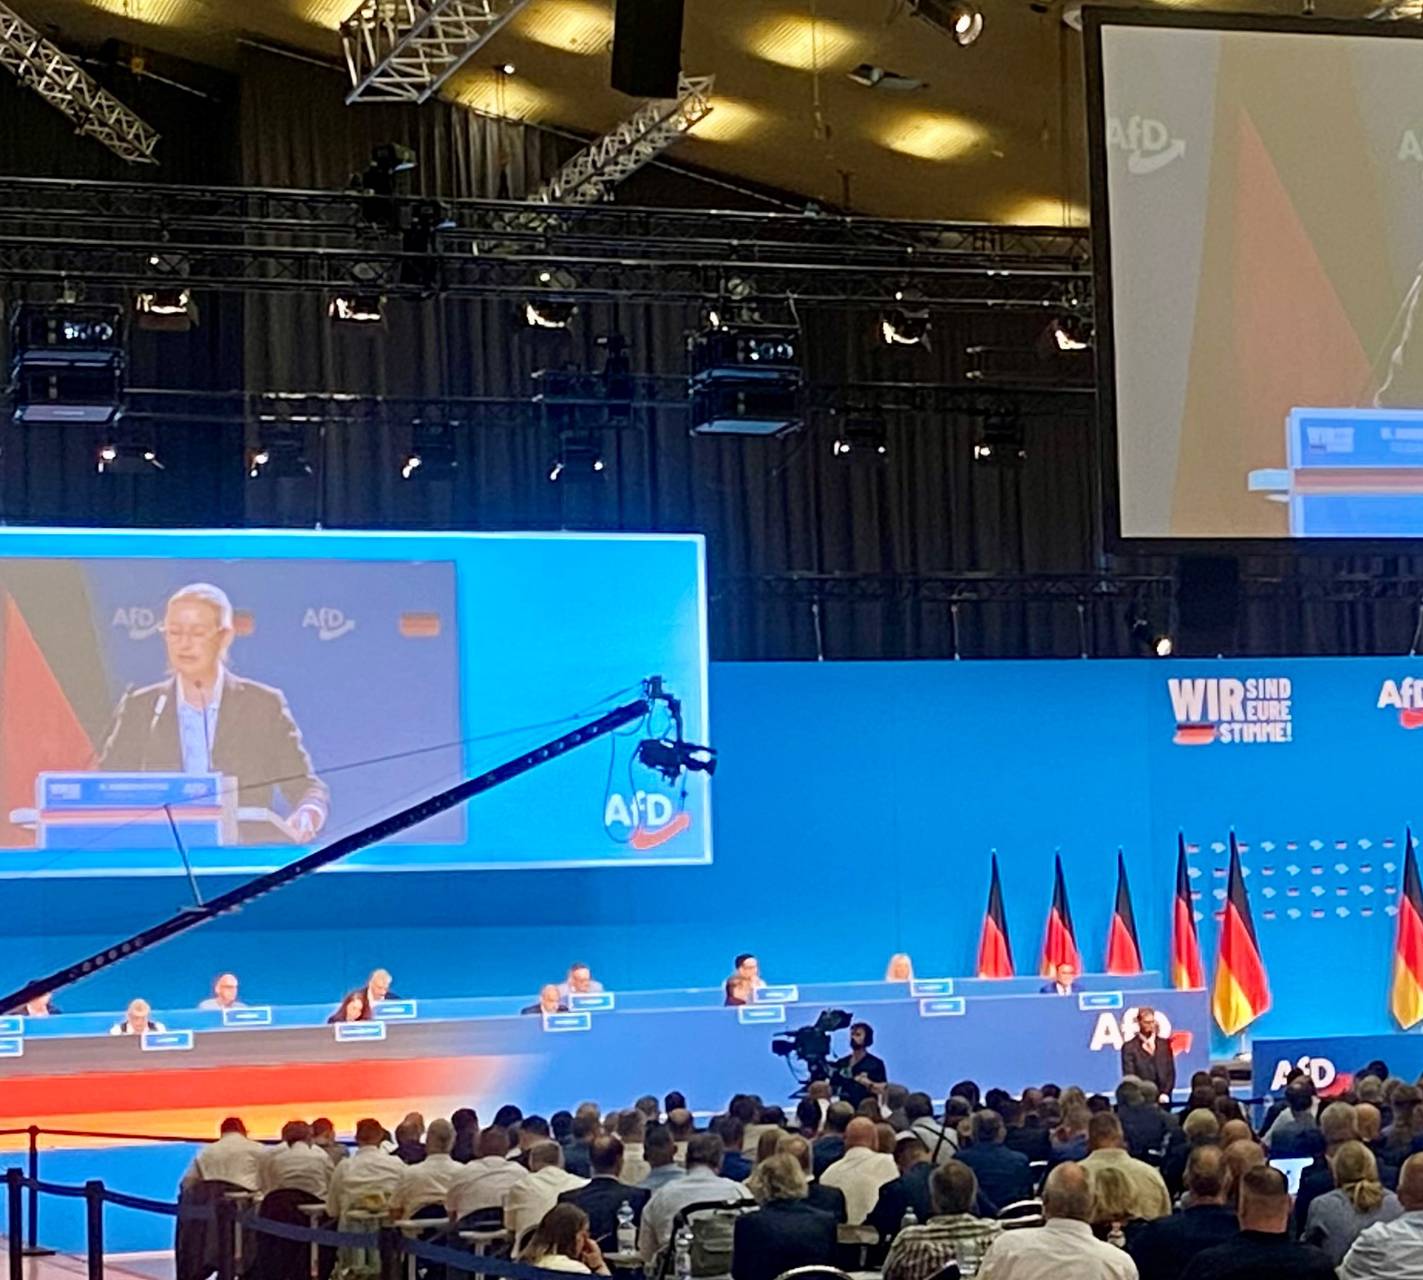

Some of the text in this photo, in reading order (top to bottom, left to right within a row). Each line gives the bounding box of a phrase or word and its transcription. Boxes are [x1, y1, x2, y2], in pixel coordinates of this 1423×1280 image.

[112, 607, 154, 627] AfD
[302, 607, 343, 628] AfD
[1168, 678, 1291, 721] WIR SIND
[1246, 700, 1292, 721] EURE
[1219, 722, 1292, 743] STIMME!
[605, 790, 673, 827] AfD
